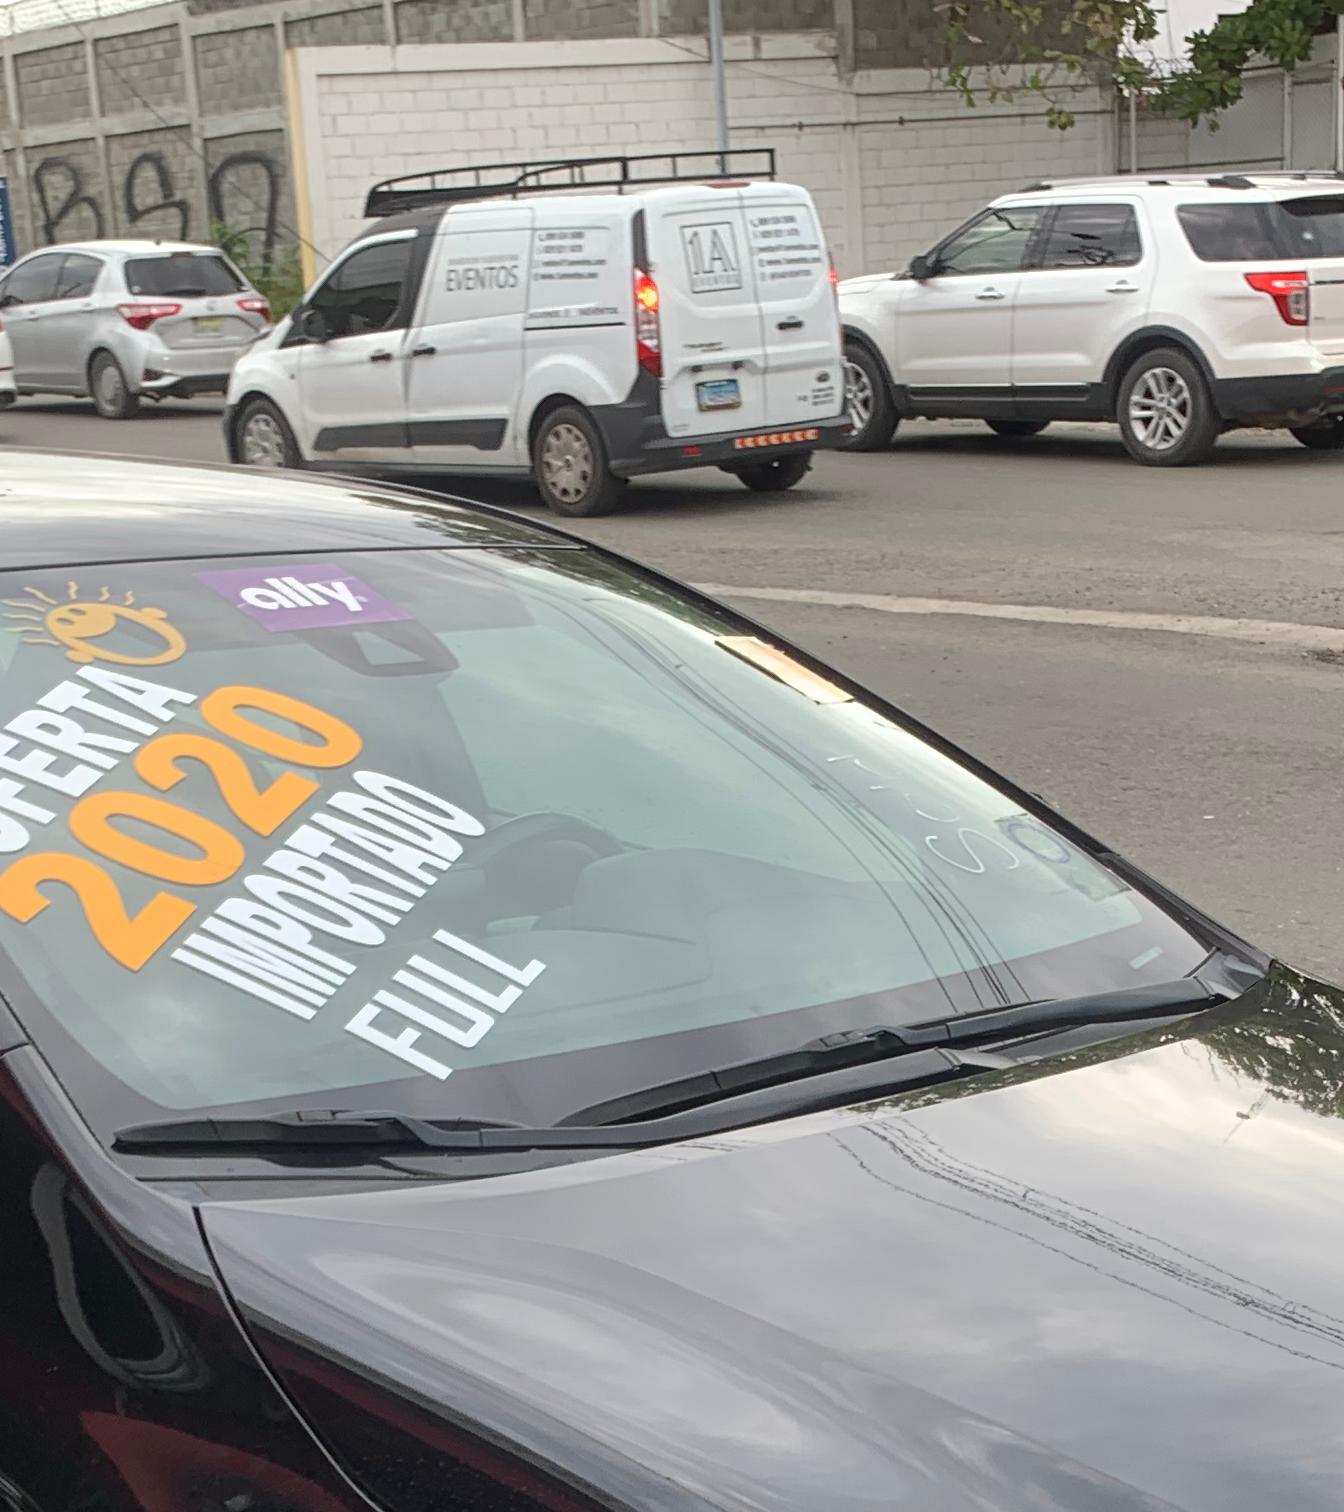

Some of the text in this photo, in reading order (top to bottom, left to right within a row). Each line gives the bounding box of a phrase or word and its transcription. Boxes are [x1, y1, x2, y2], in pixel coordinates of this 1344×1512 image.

[445, 264, 520, 293] EVENTOS
[239, 576, 368, 612] ally
[170, 769, 486, 1021] IMPORTADO
[343, 928, 547, 1081] FULL
